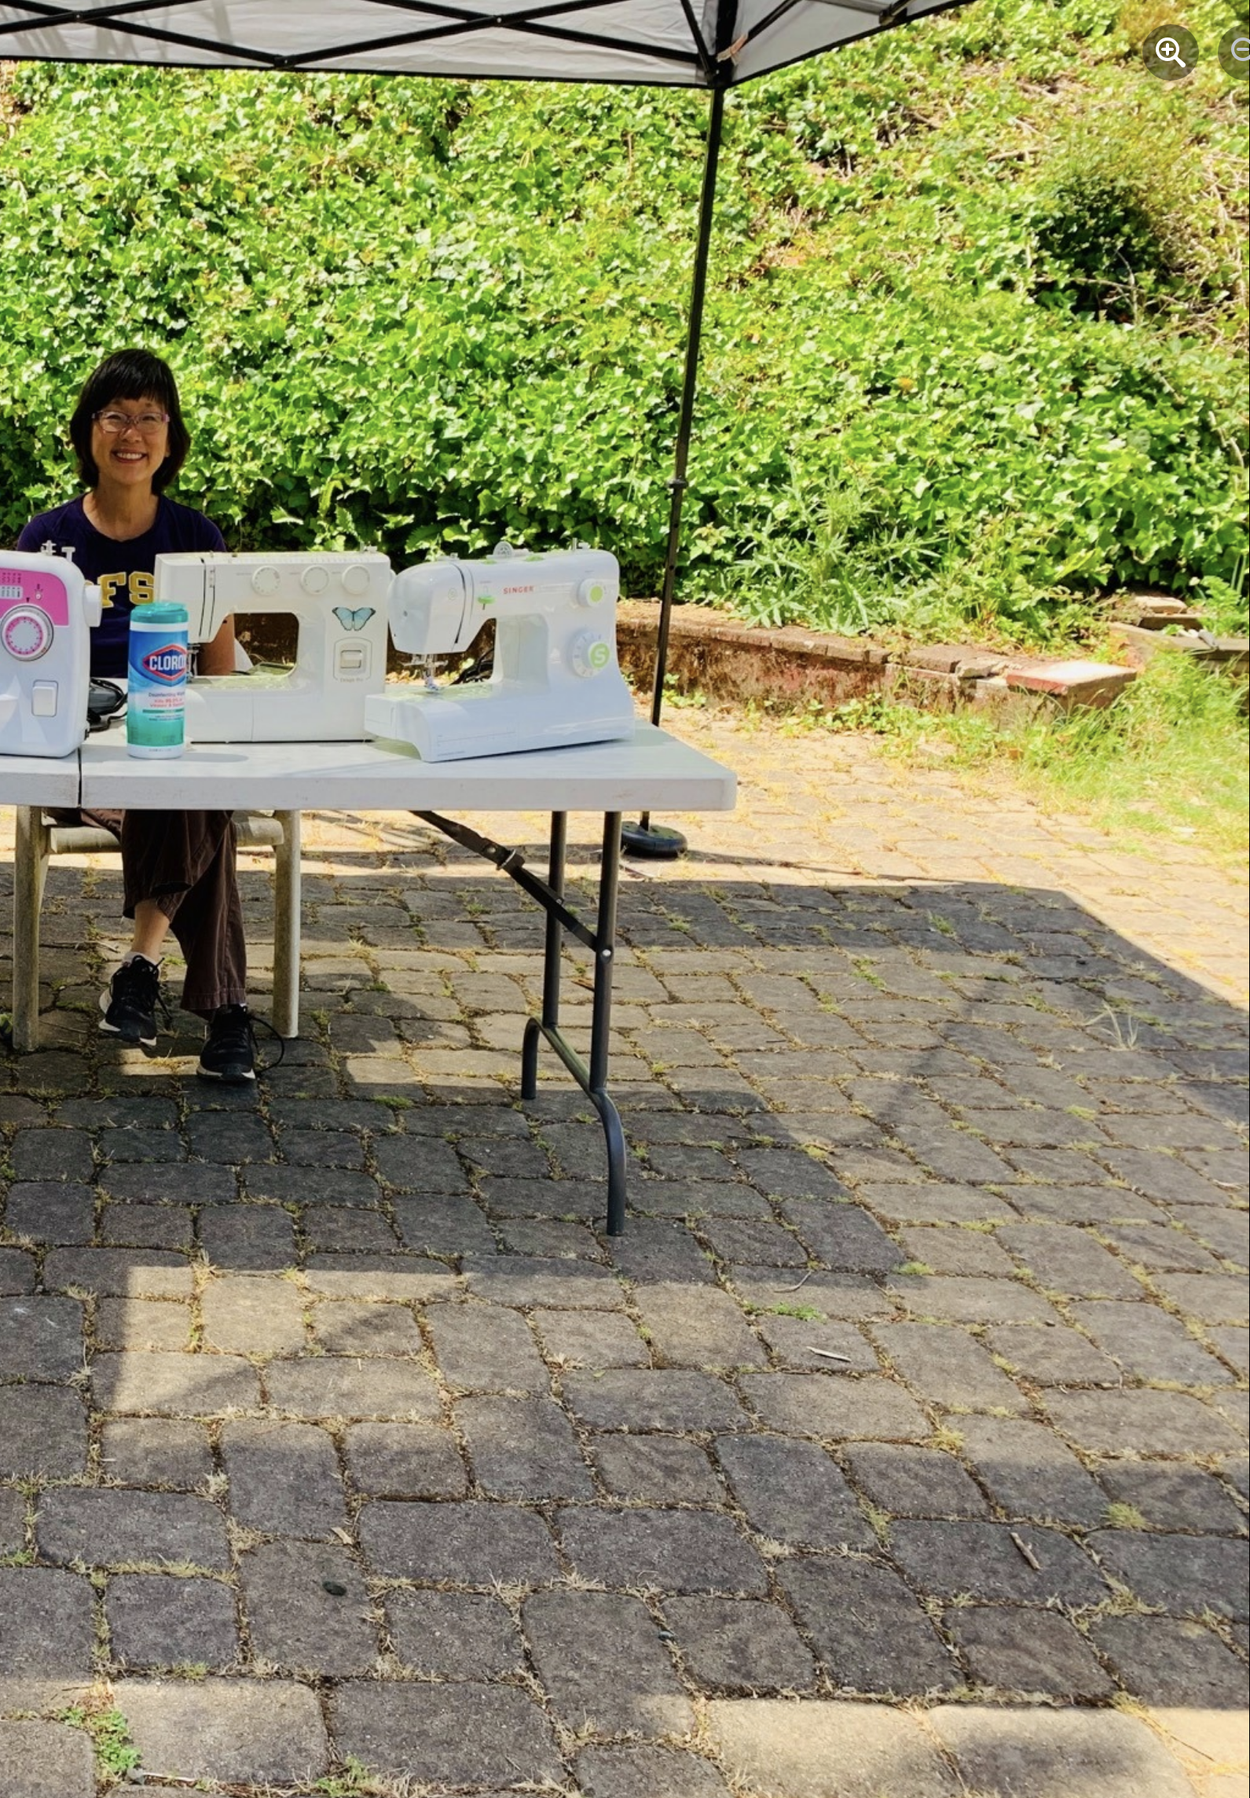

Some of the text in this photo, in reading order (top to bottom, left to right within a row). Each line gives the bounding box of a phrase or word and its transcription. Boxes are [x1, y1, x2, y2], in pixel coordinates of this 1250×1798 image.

[85, 571, 155, 609] FS
[503, 585, 535, 595] SINGER
[149, 654, 186, 671] CLORO
